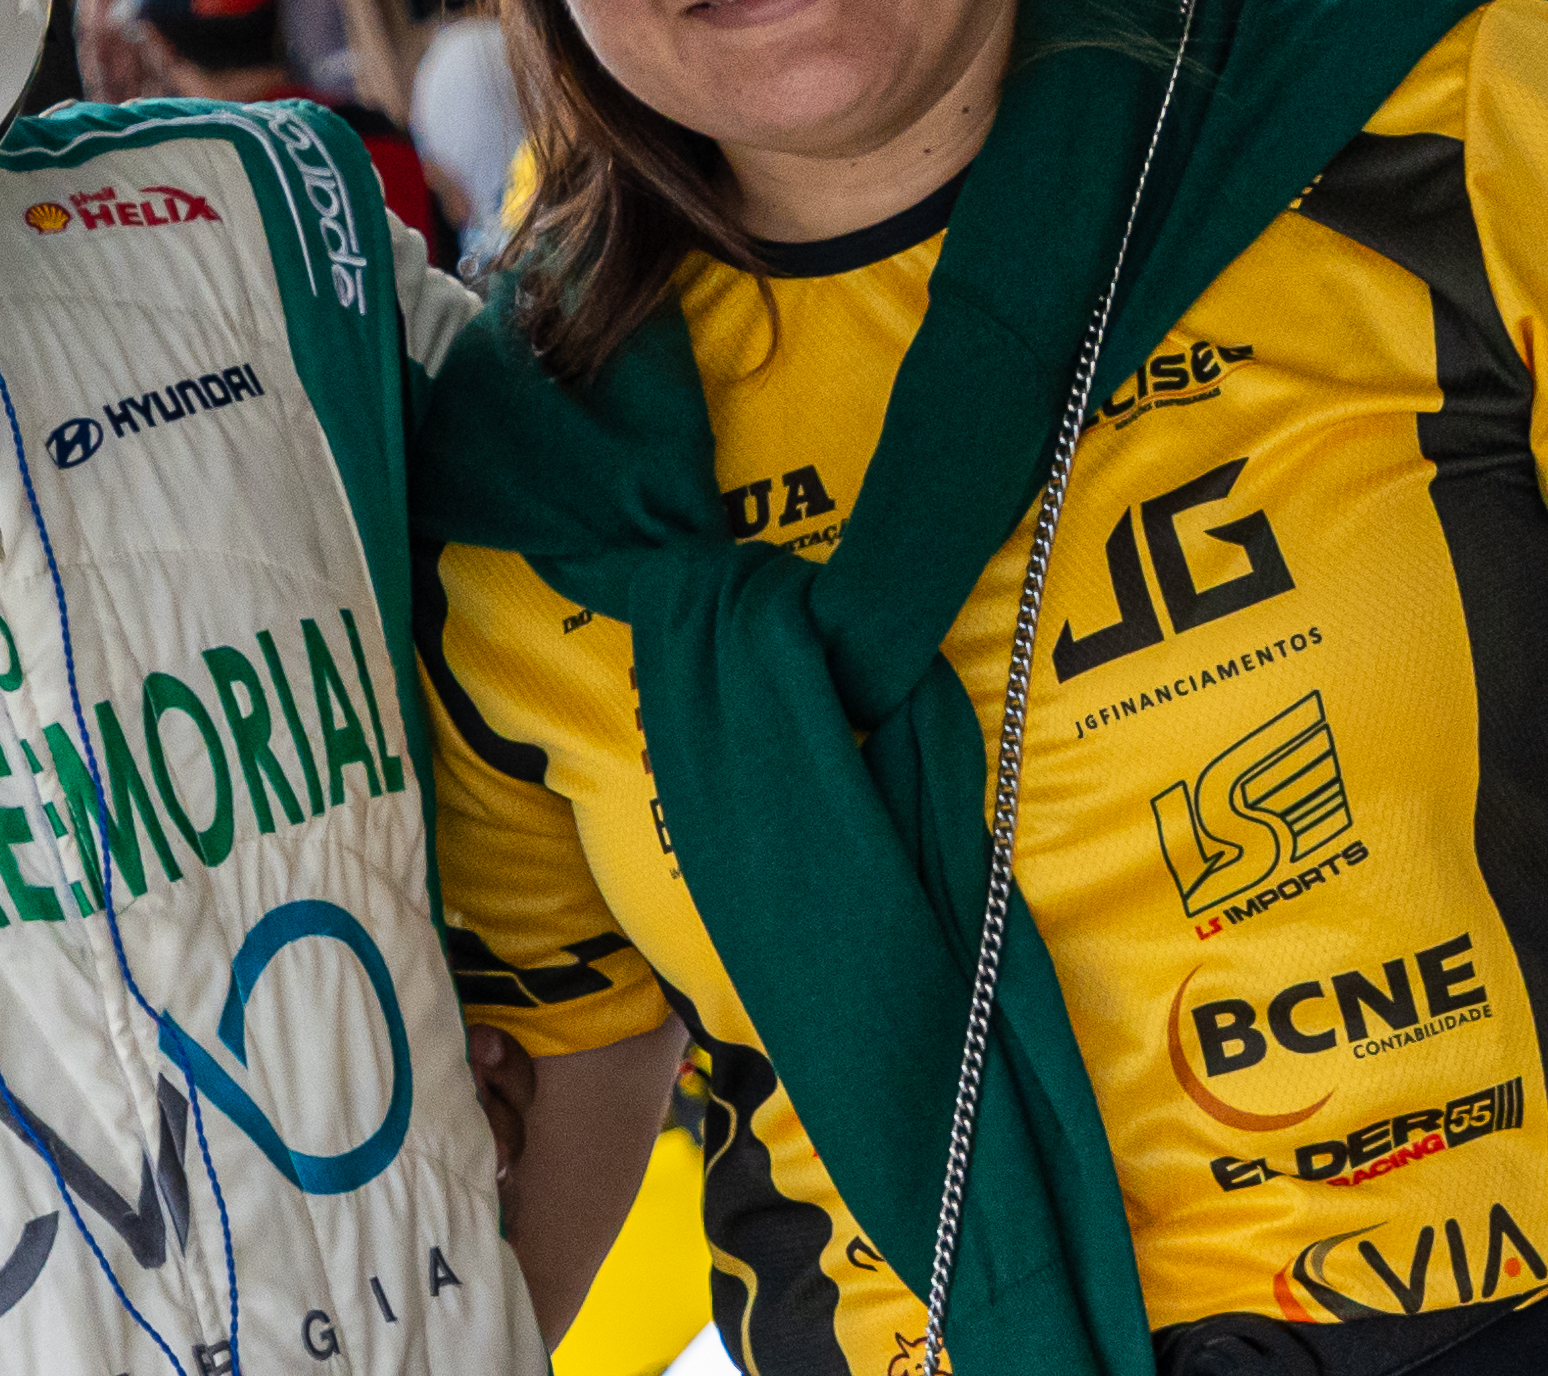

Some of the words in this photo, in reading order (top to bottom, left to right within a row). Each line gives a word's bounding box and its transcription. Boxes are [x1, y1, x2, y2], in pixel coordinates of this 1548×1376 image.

[77, 185, 223, 230] HELIX
[104, 363, 265, 438] HYUNDAI
[1051, 457, 1297, 683] JG
[1222, 839, 1371, 926] IMPORTS
[1191, 931, 1489, 1079] BCNE
[1352, 1002, 1494, 1061] CONTABILIDADE
